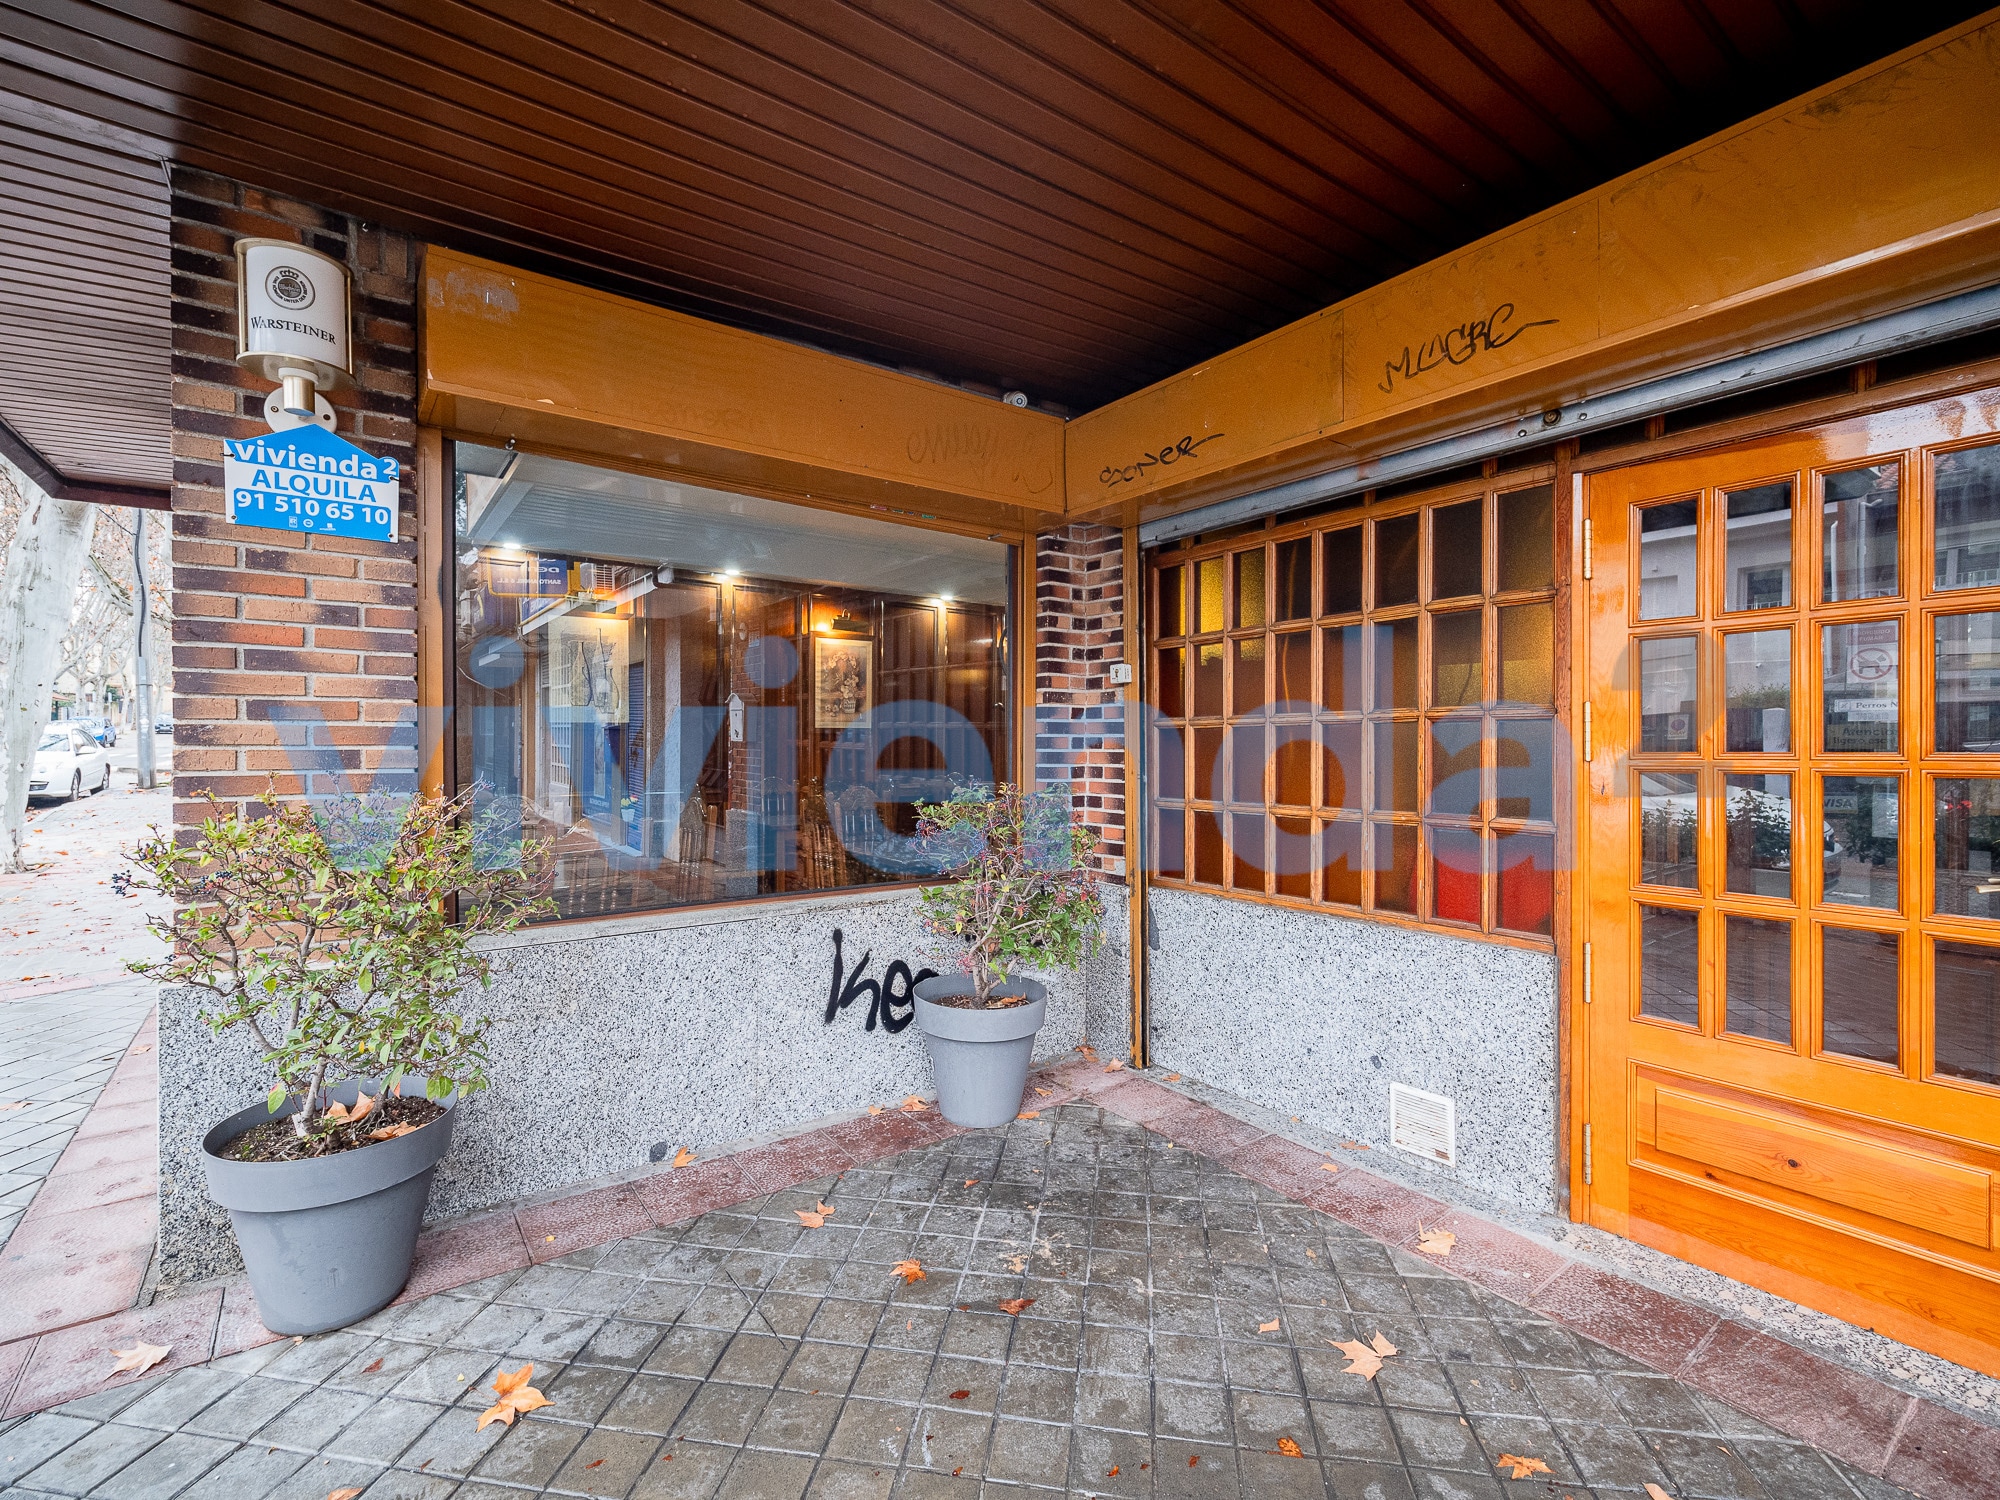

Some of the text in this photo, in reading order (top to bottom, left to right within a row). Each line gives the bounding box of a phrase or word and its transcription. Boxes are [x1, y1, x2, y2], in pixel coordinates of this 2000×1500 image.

[250, 316, 336, 345] WARSTEINER
[234, 440, 378, 480] vivienda
[251, 469, 376, 502] ALQUILA
[235, 490, 389, 525] 91 510 65 10
[1824, 798, 1853, 808] VISA
